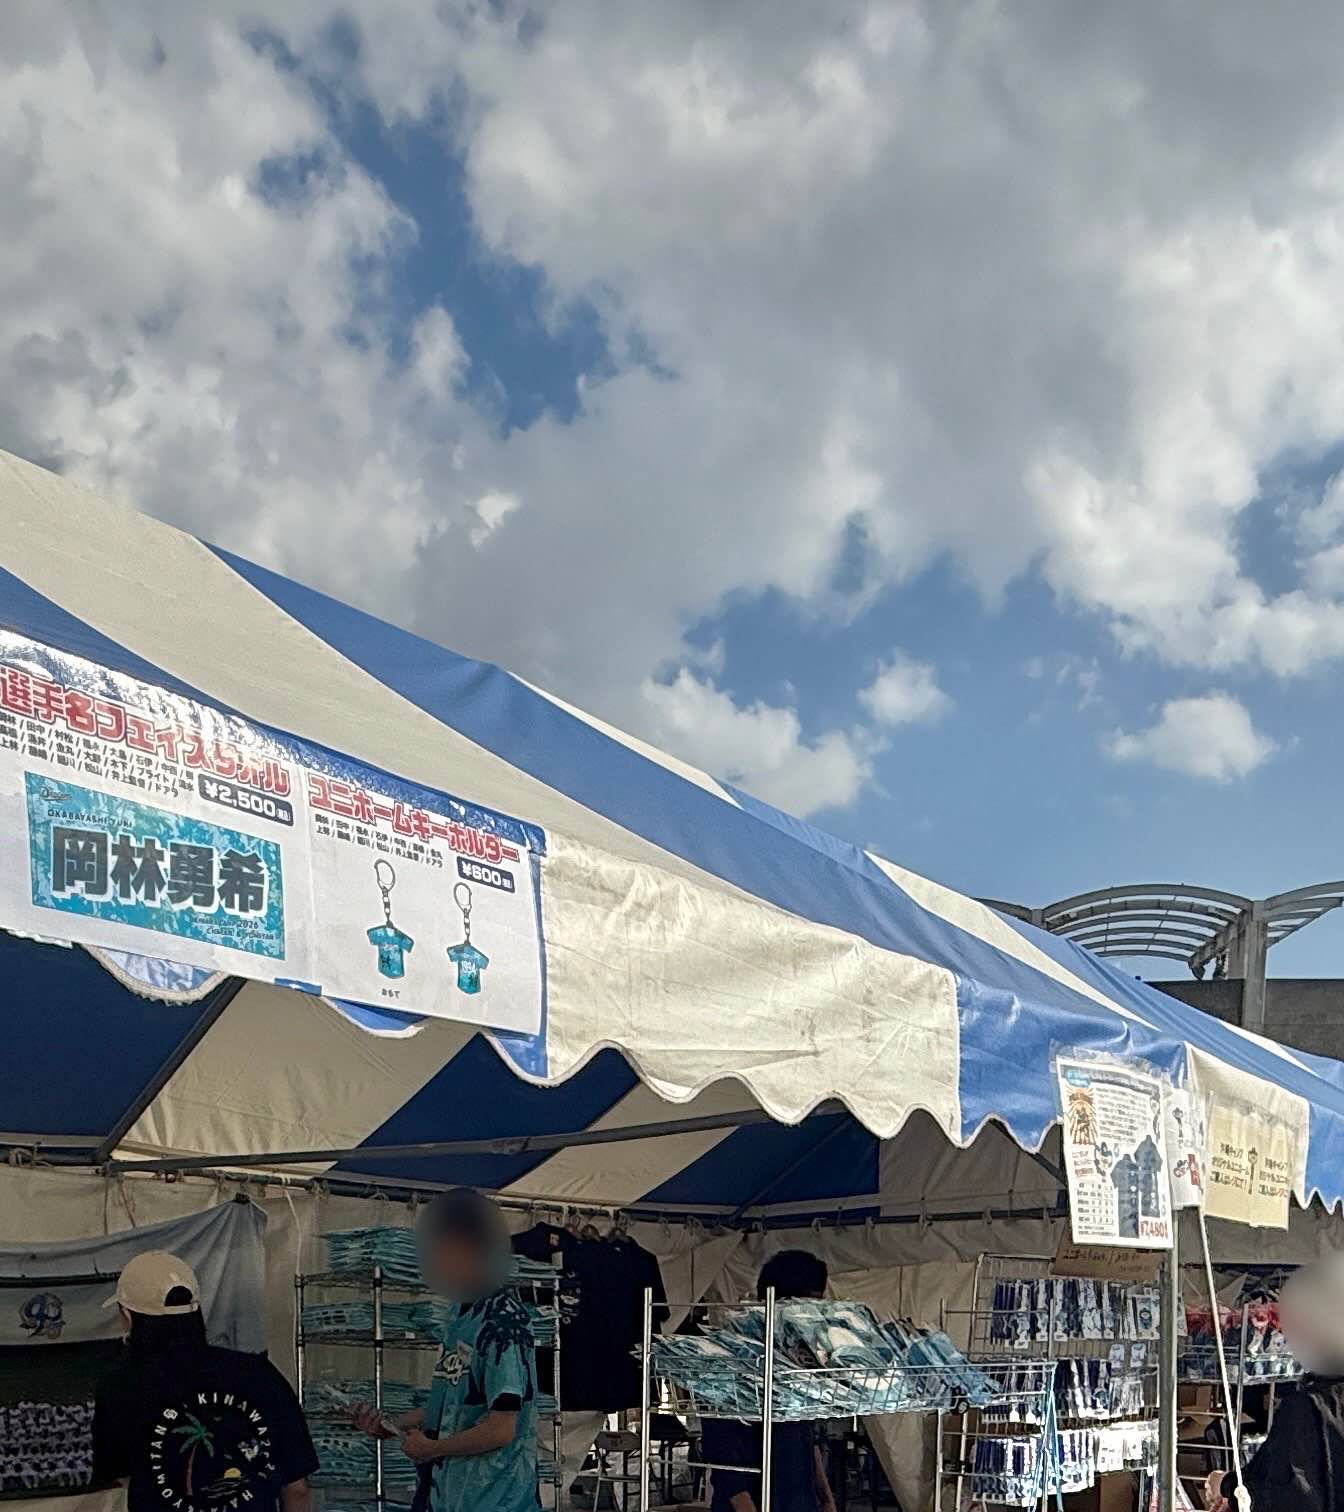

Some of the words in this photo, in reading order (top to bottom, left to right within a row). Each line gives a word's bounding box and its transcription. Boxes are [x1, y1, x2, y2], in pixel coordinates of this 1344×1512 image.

[205, 782, 276, 817] ¥2,500
[308, 772, 520, 864] ユニホームキーホルダー
[52, 825, 266, 914] 岡林勇希
[461, 862, 503, 886] ¥600
